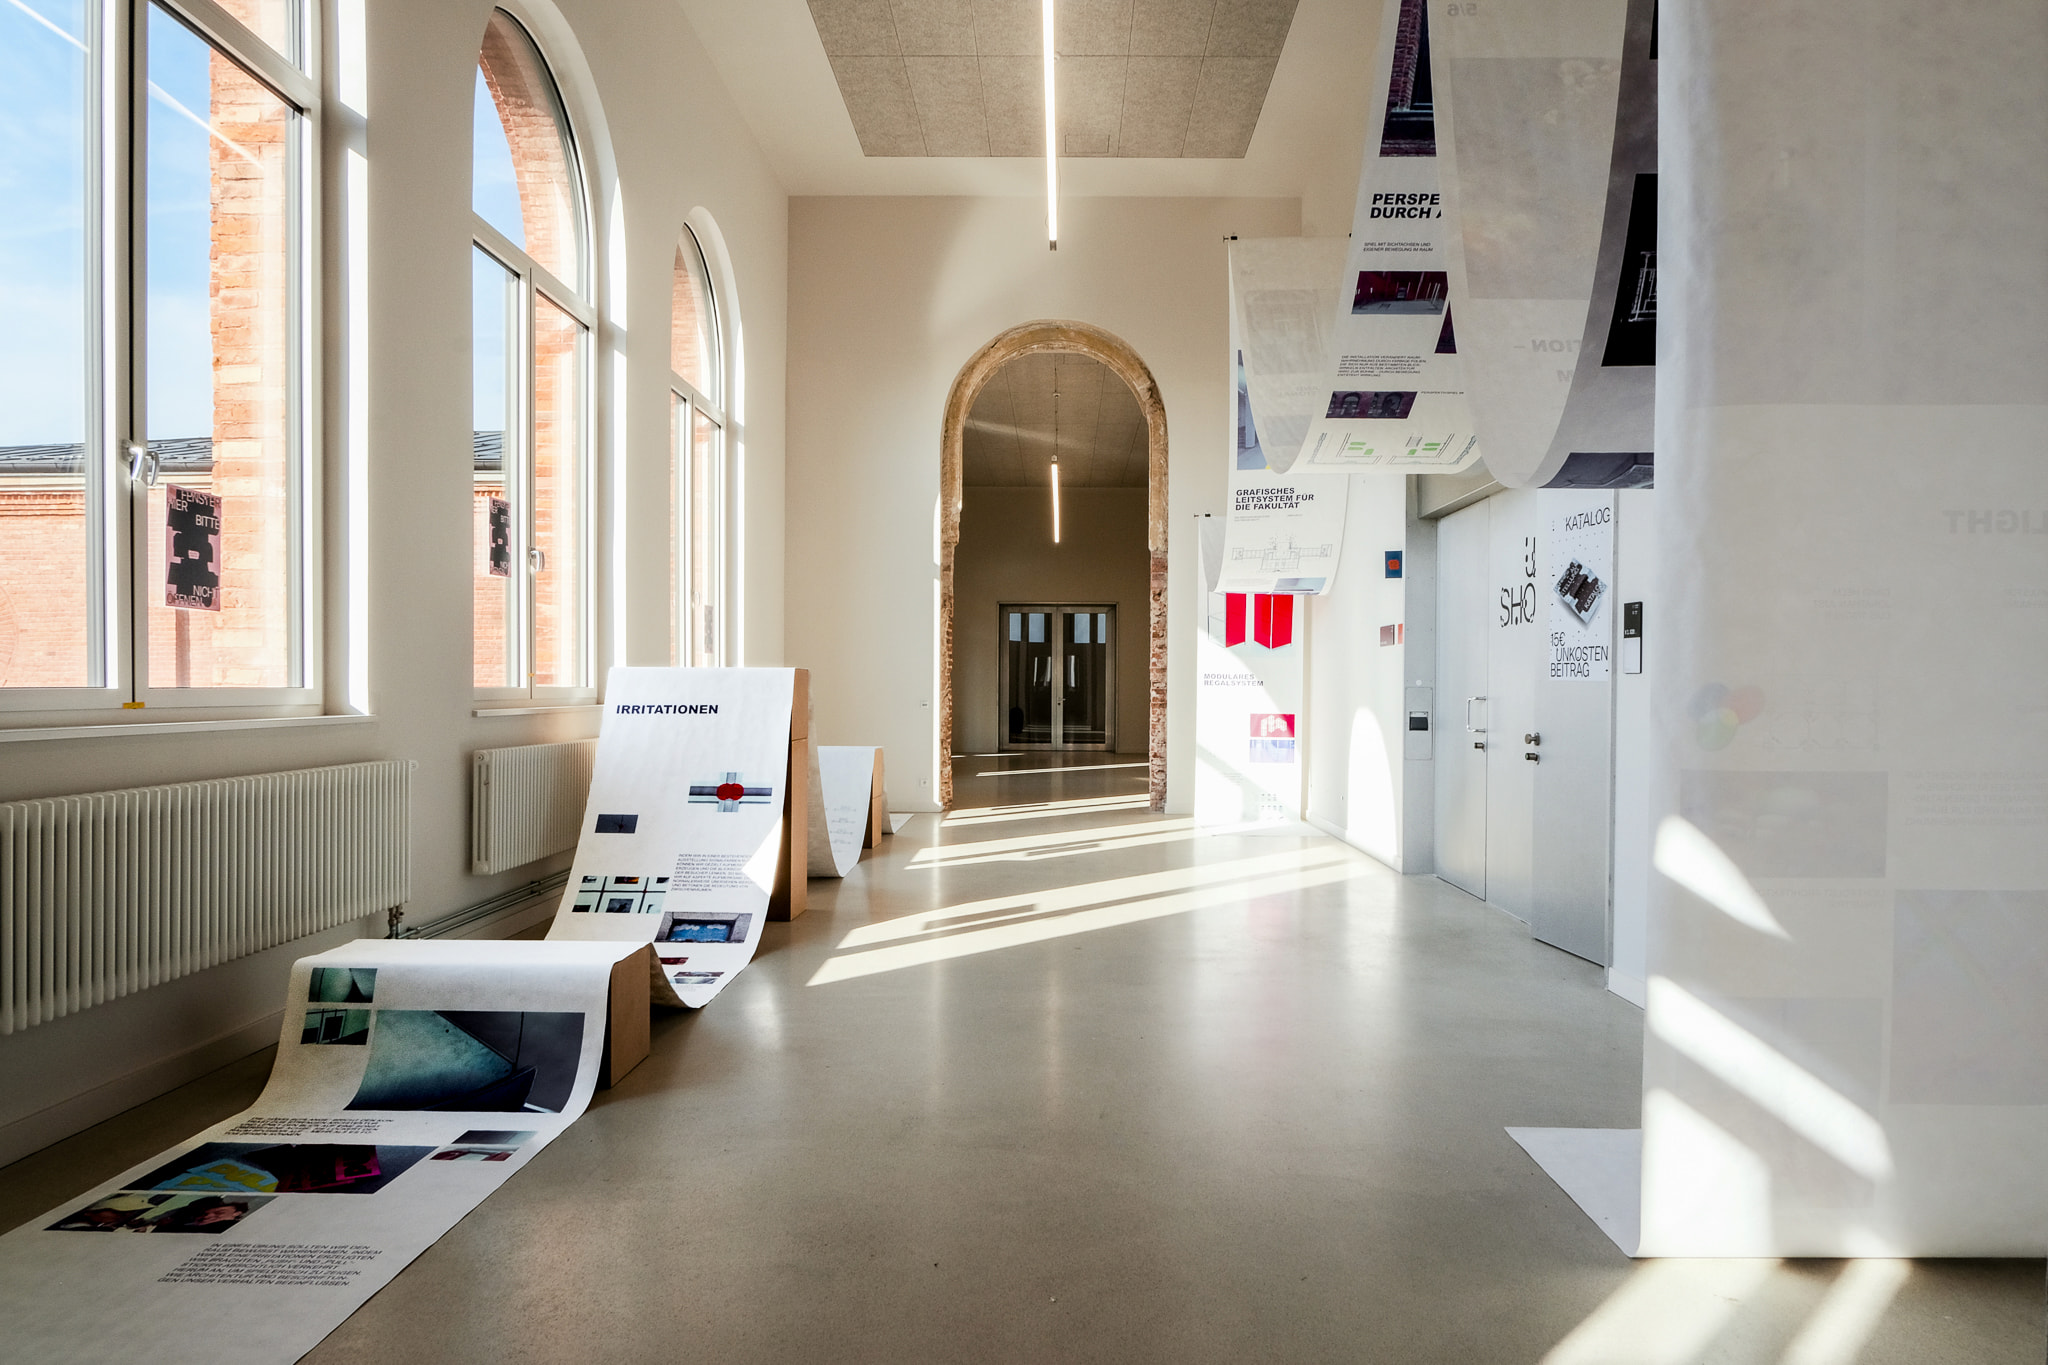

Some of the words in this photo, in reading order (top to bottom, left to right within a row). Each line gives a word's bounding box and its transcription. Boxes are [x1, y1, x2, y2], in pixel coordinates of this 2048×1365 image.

[1372, 194, 1440, 205] PERSPE
[1370, 207, 1432, 218] DURCH
[1236, 488, 1295, 496] GRAFISCHES
[1236, 495, 1293, 504] LEITSYSTEM
[1296, 493, 1314, 501] FÜR
[1253, 502, 1300, 510] FAKULTÄT
[195, 514, 220, 529] BITTE
[1566, 507, 1610, 532] KATALOG
[1550, 632, 1565, 646] 15€
[1556, 646, 1608, 662] UNKOSTEN
[1551, 662, 1590, 678] BEITRAG
[616, 705, 719, 714] IRRITATIONEN
